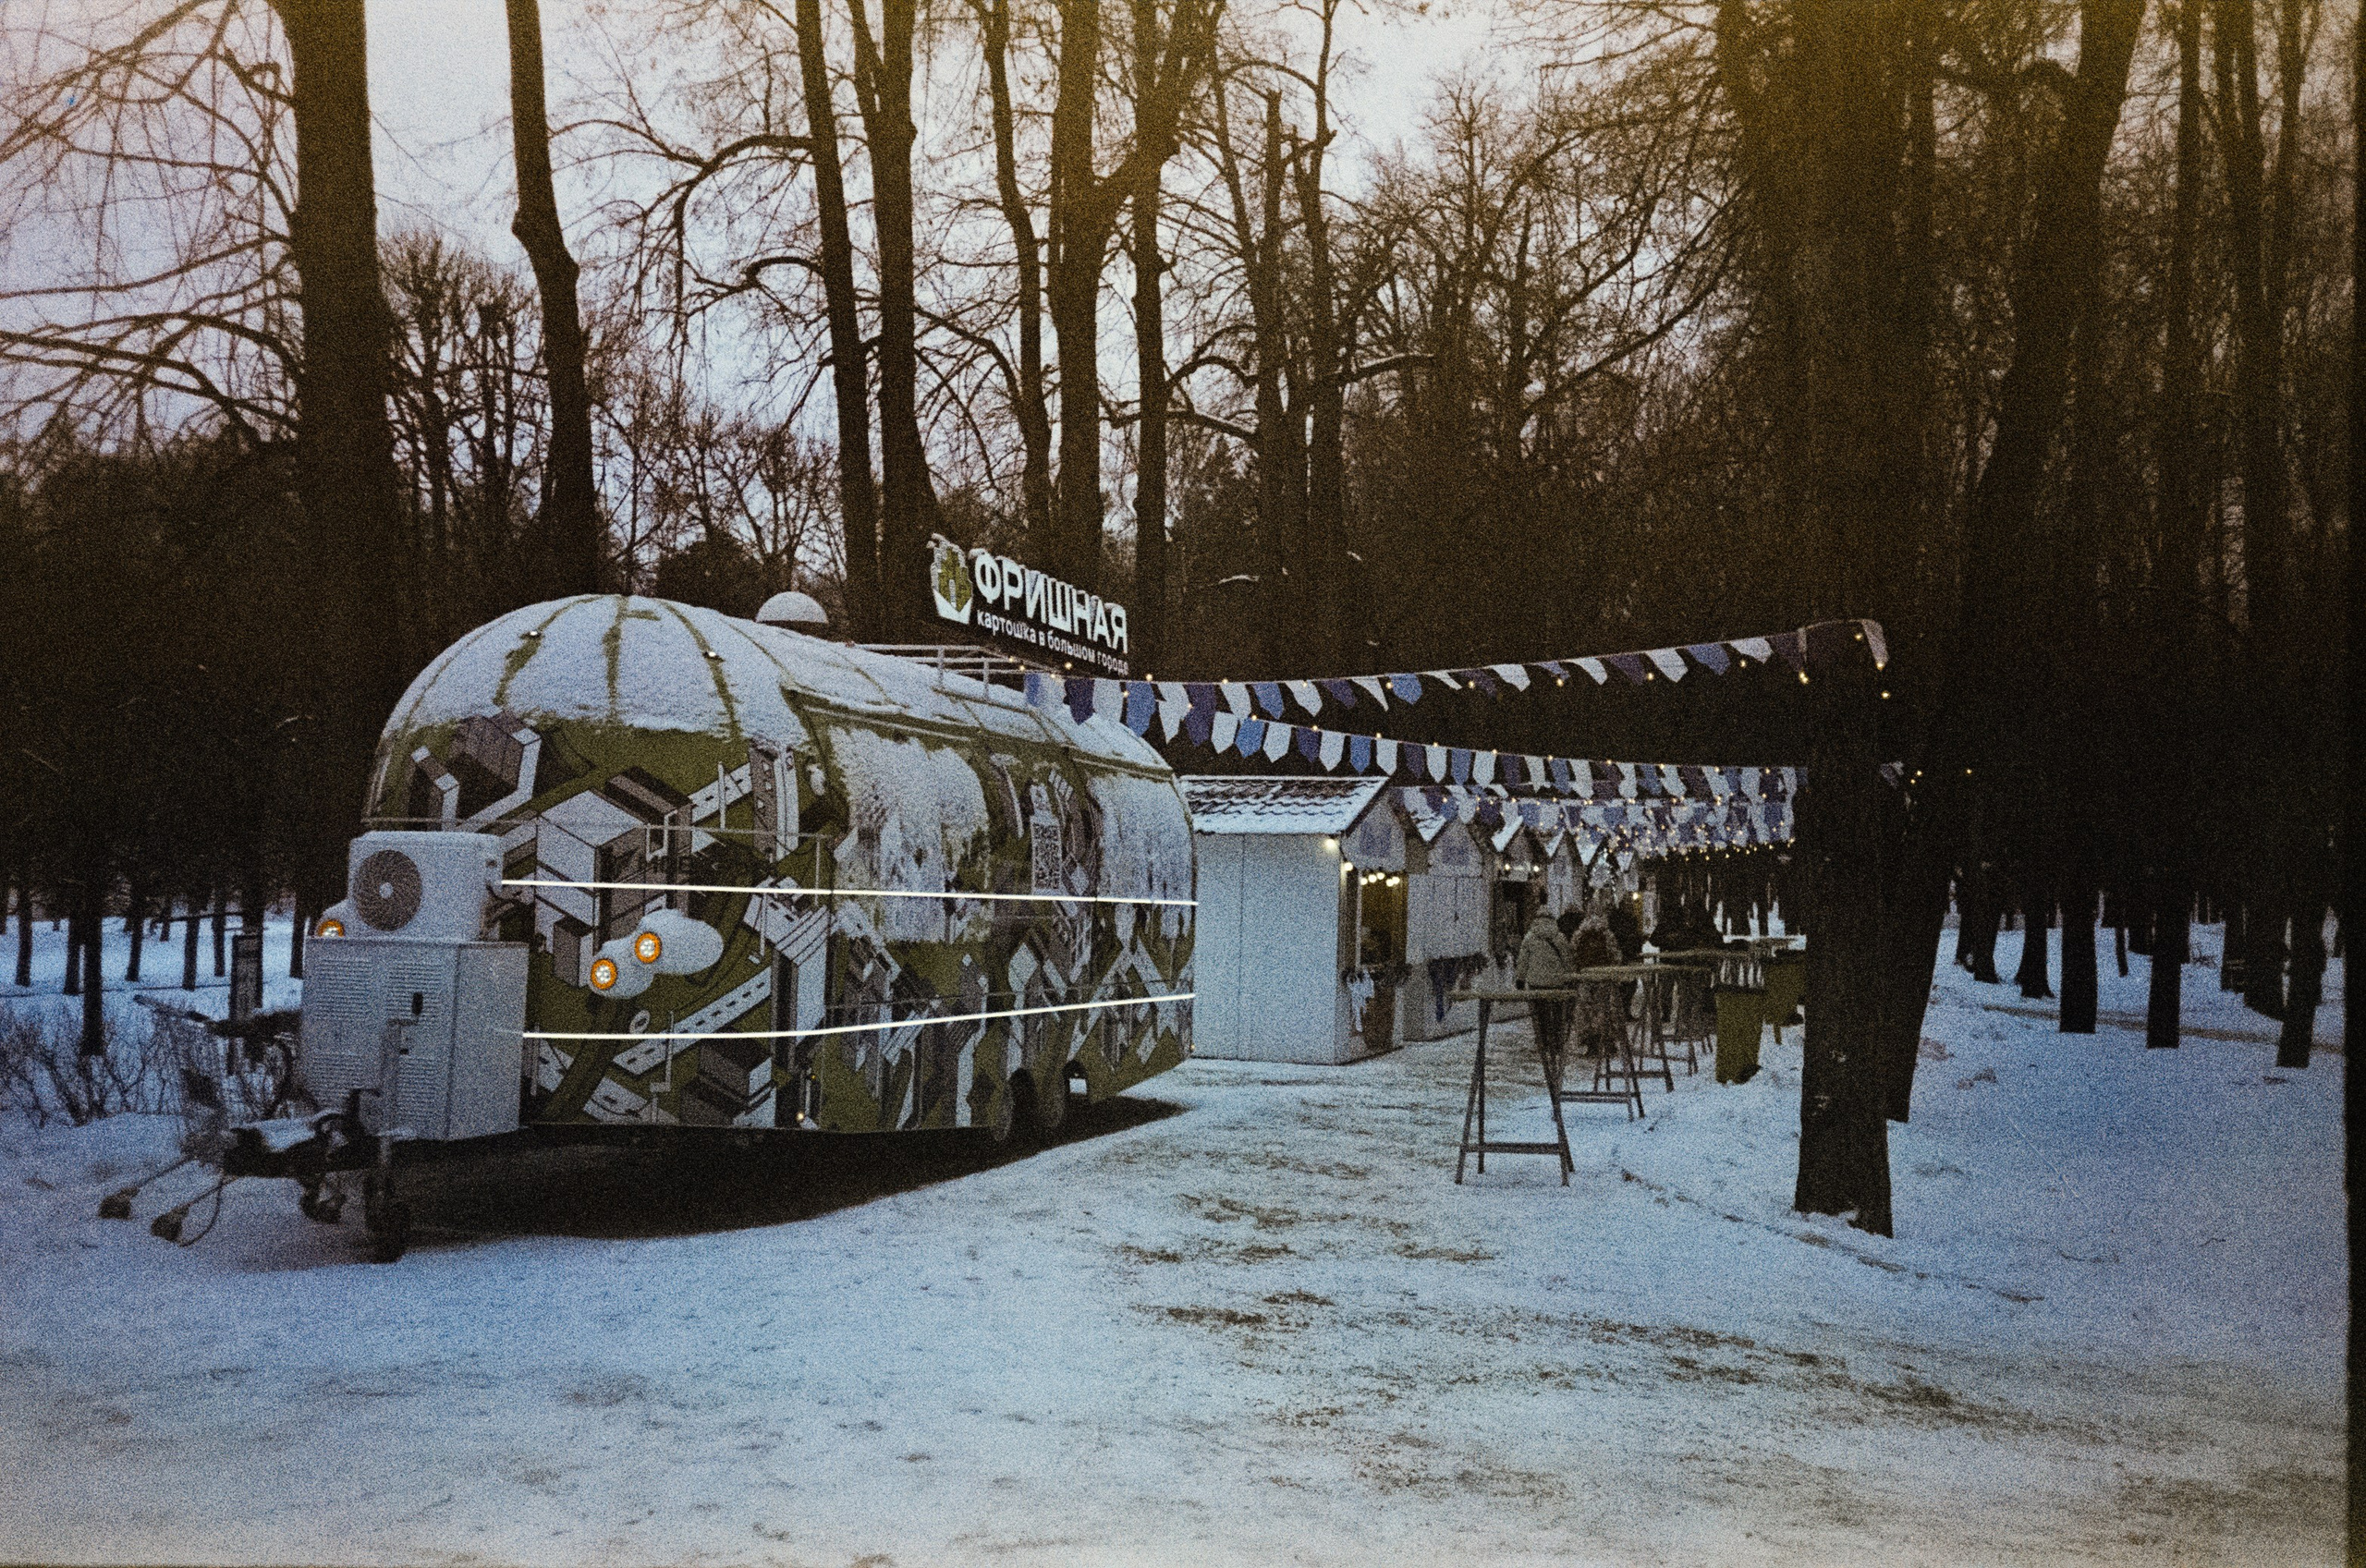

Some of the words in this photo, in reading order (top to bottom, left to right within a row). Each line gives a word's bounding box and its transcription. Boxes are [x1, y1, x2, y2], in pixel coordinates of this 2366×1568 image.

[975, 550, 1128, 654] ФРИШНАЯ
[977, 610, 1036, 644] картошка
[1039, 630, 1045, 647] в
[1047, 629, 1095, 663] большом
